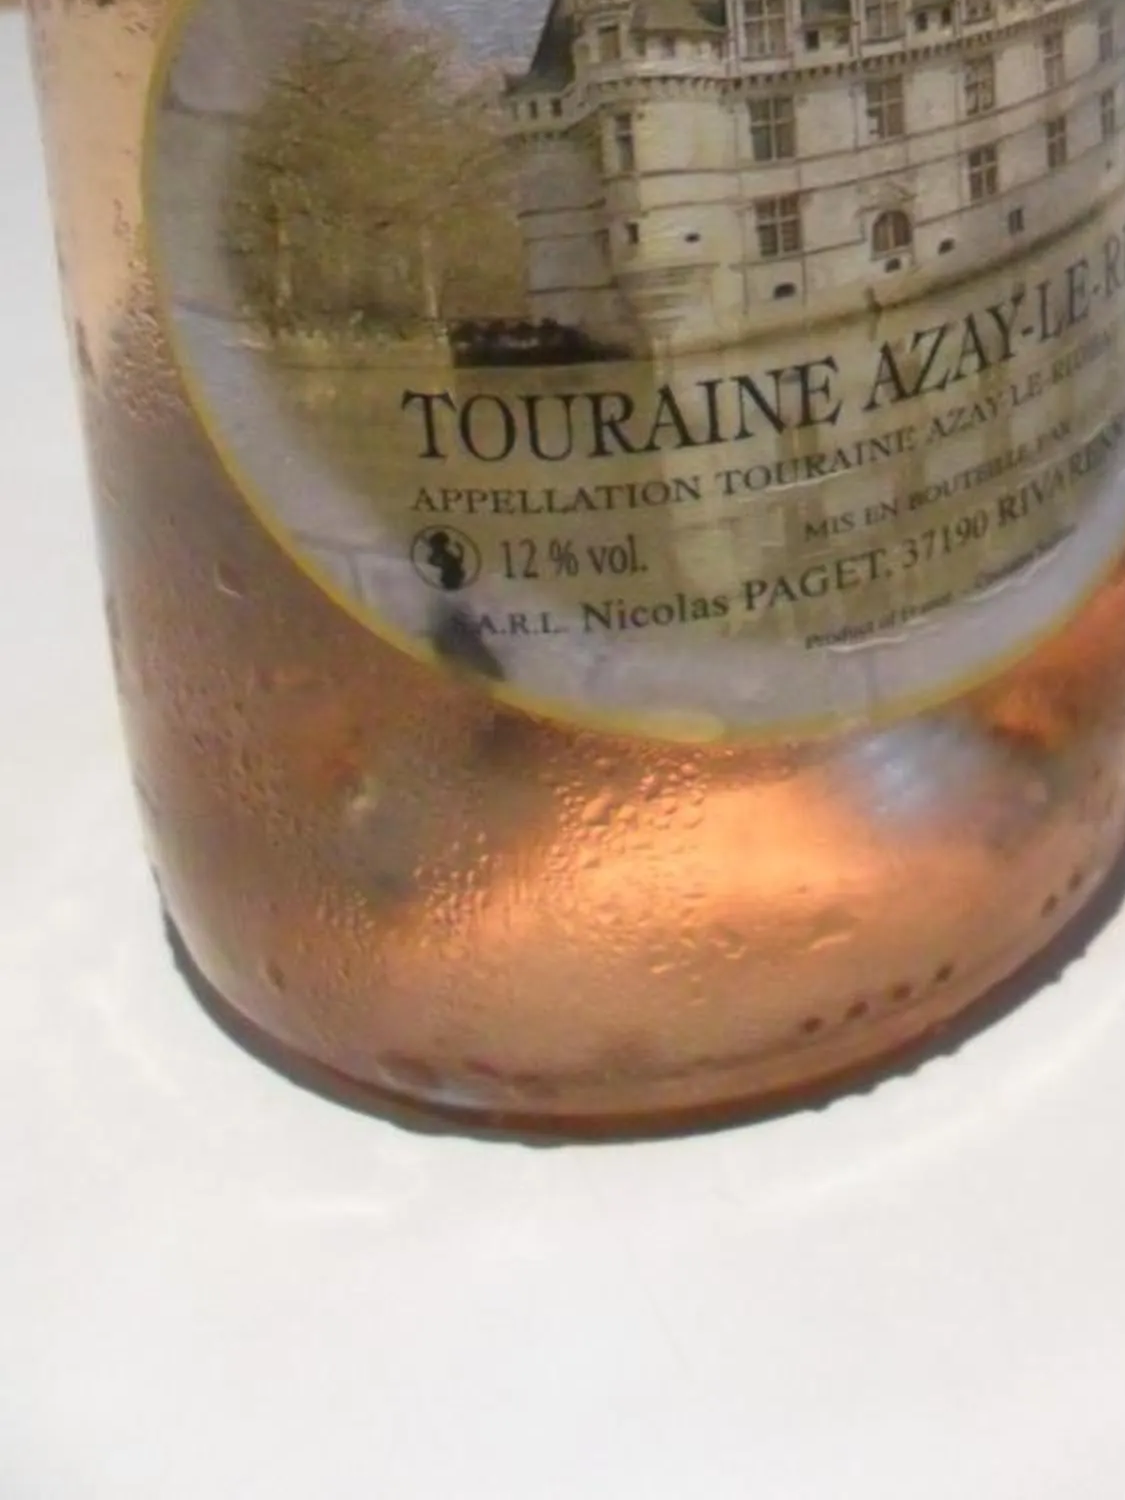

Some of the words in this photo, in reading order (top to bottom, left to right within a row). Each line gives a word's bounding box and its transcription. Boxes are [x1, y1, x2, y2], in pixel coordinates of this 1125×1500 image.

[401, 355, 843, 462] TOURAINE
[410, 474, 702, 514] APPELLATION
[716, 425, 917, 497] TOURAINE
[502, 537, 540, 580] 12
[804, 512, 855, 542] MIS
[864, 498, 899, 527] EN
[583, 592, 729, 635] Nicolas
[902, 508, 989, 570] 37190
